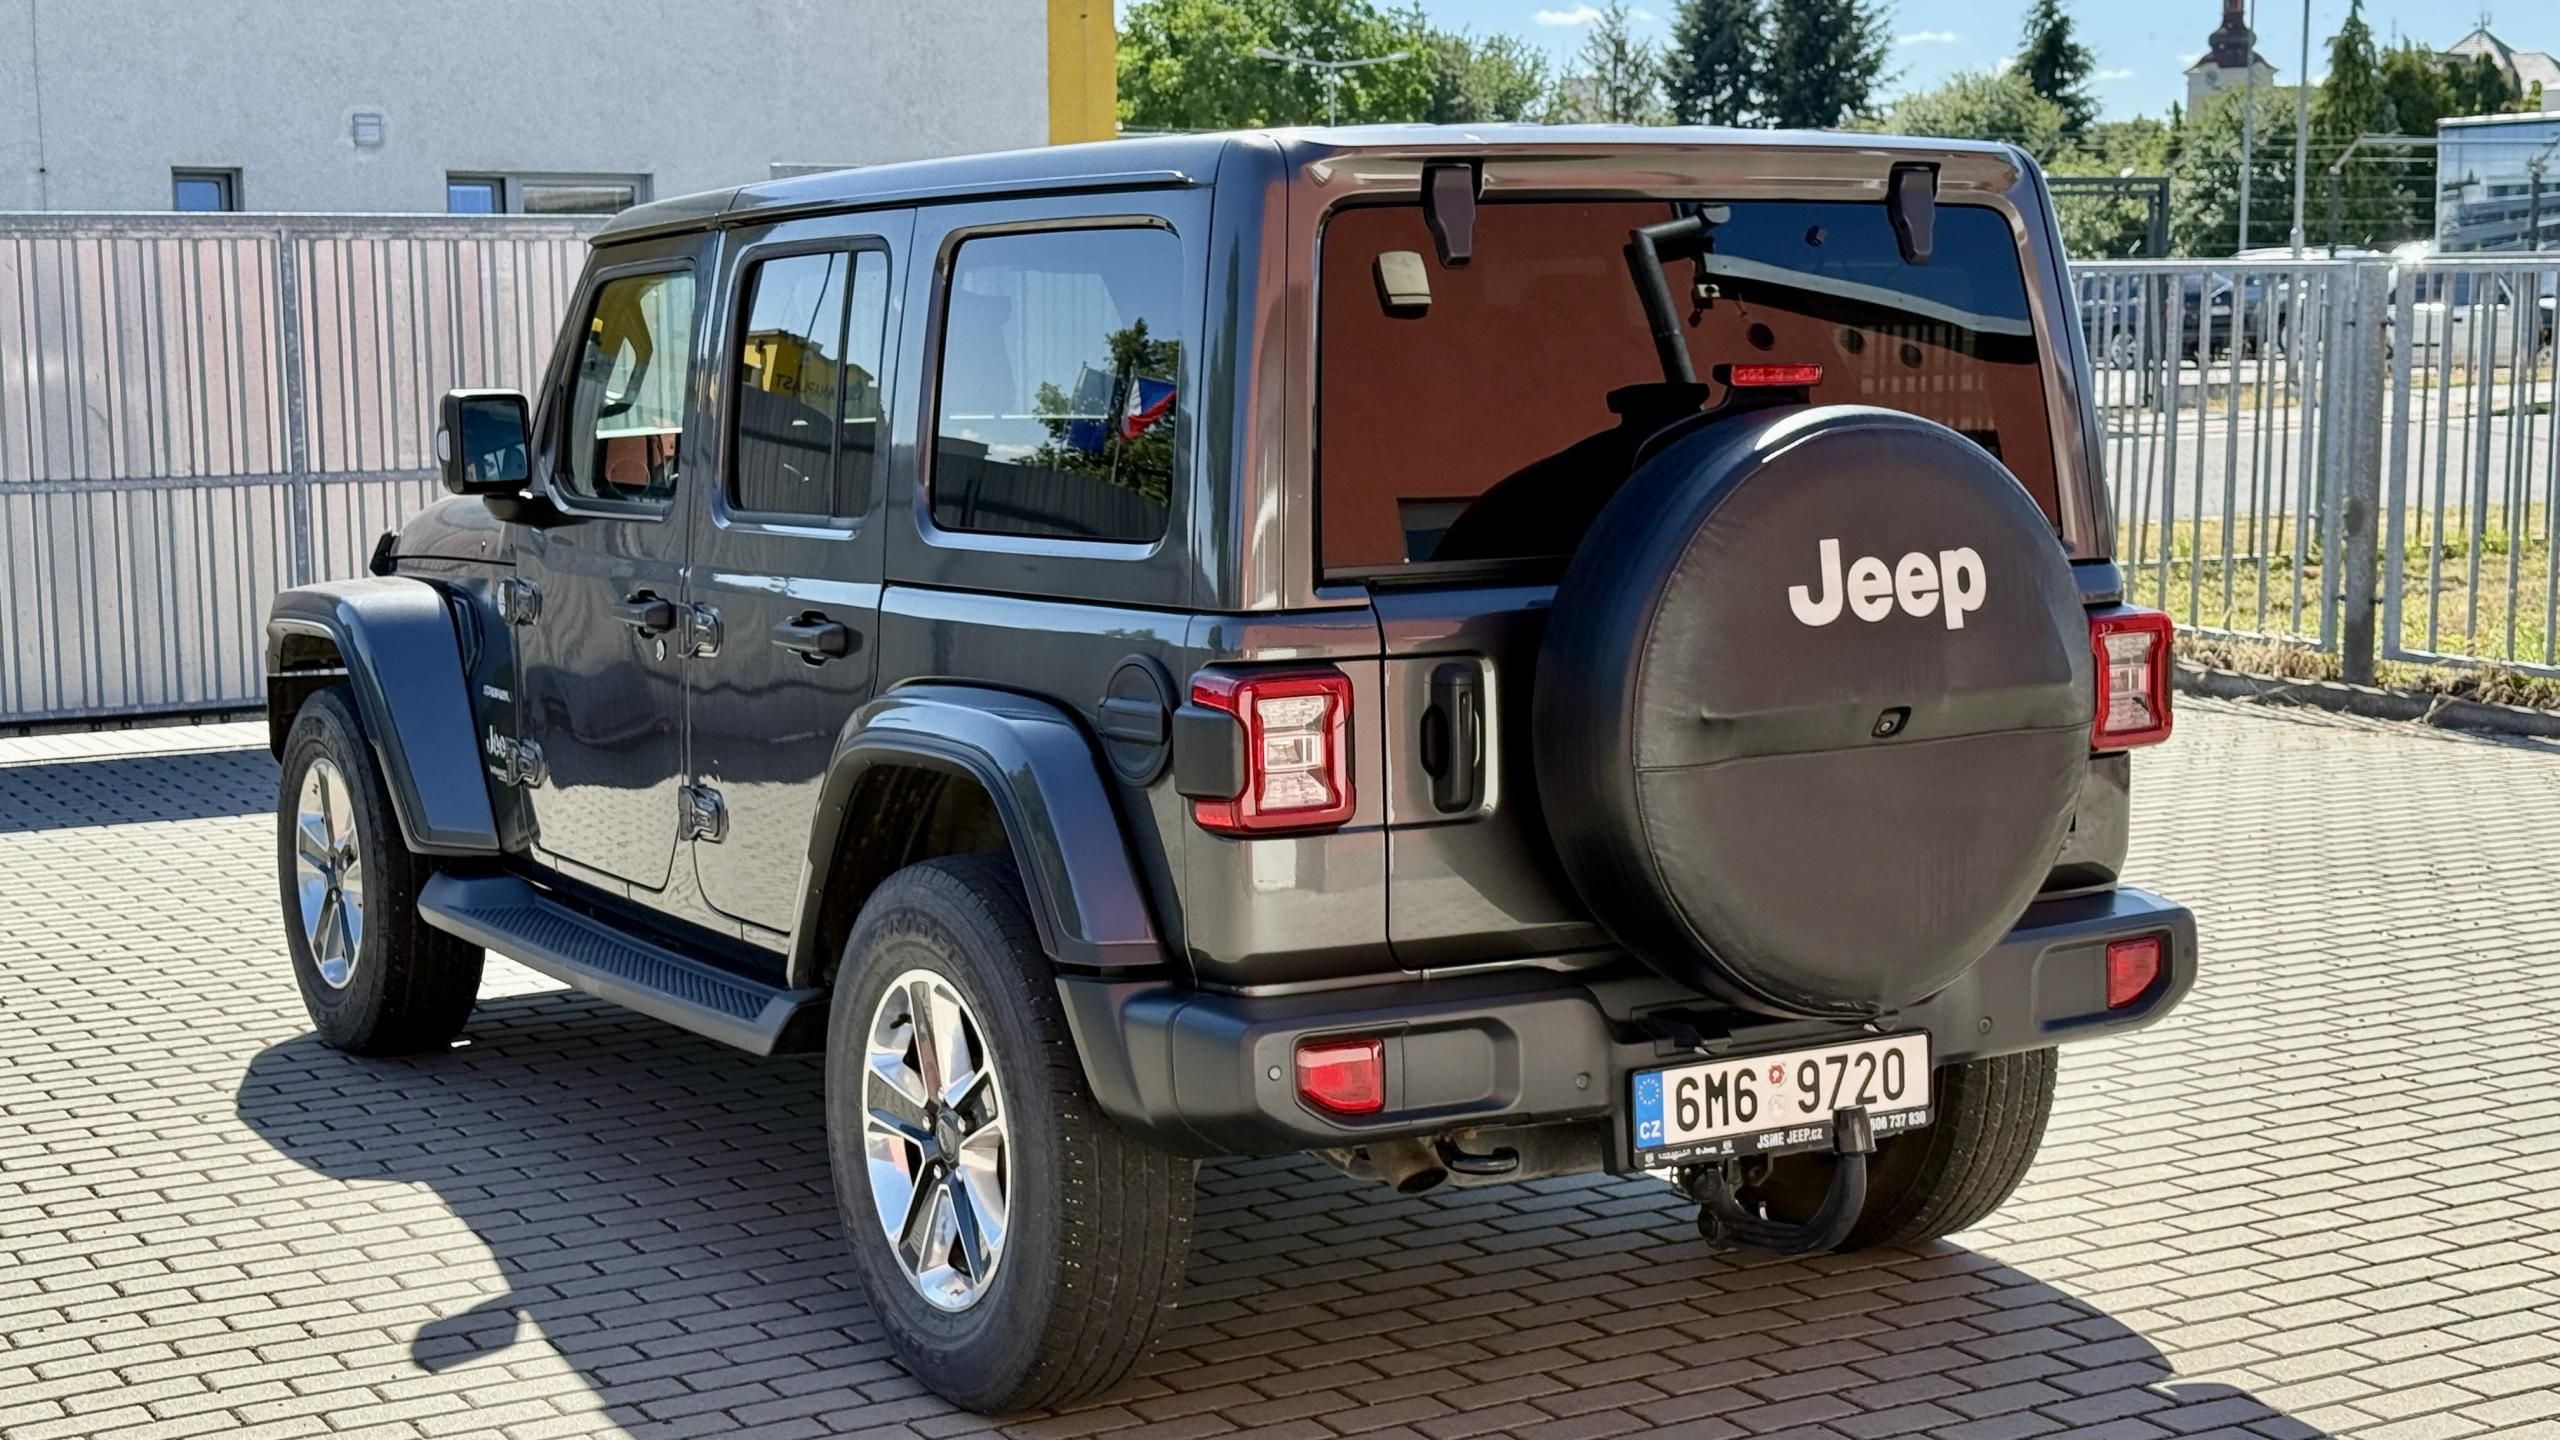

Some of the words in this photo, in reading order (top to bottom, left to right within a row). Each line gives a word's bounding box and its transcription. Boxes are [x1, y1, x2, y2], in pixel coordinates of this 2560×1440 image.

[1788, 538, 1987, 630] Jeep
[486, 725, 507, 759] Jee
[1676, 1068, 1757, 1131] 6M6
[1797, 1047, 1905, 1113] 9720
[1639, 1120, 1661, 1139] CZ
[1757, 1131, 1785, 1149] JSME
[1889, 1113, 1907, 1128] 737
